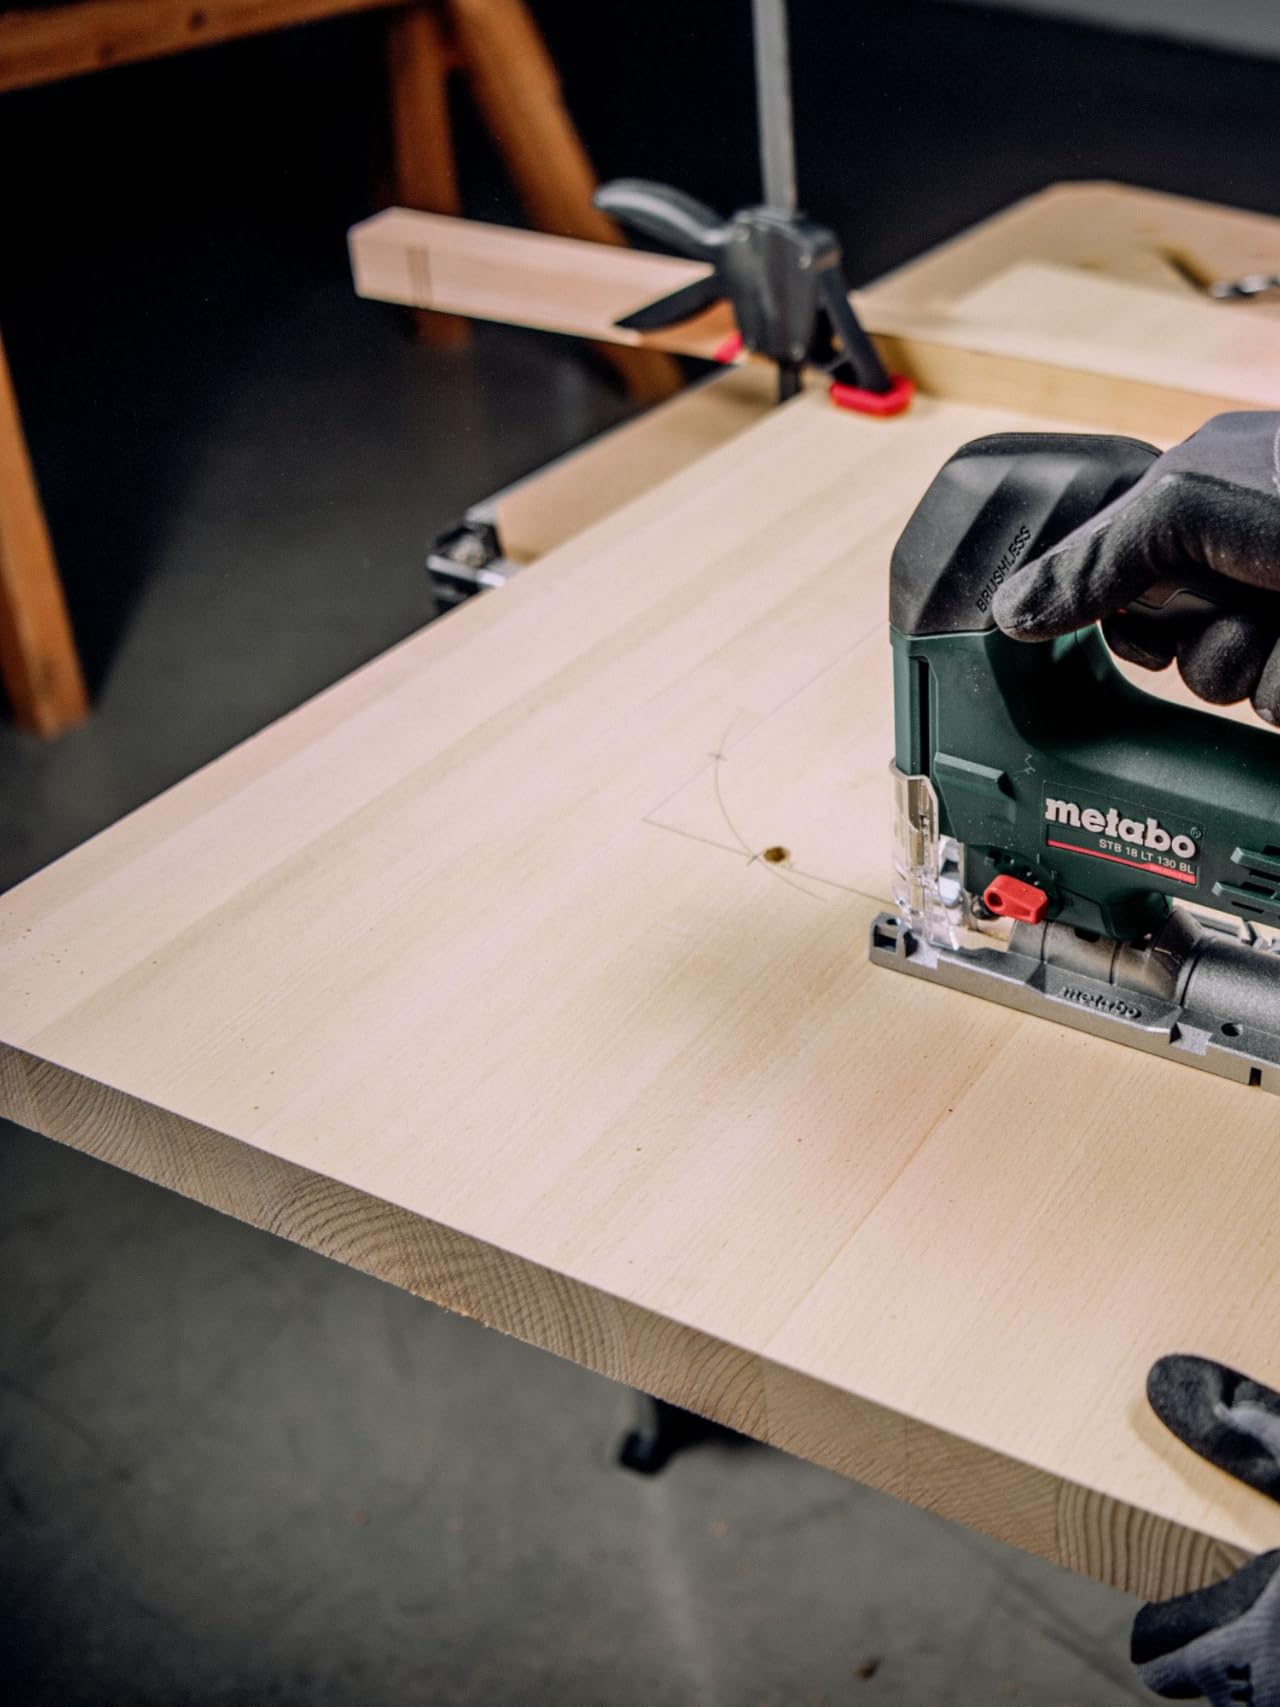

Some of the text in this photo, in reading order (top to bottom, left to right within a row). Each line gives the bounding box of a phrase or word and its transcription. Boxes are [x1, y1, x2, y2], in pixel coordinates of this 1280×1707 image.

[976, 526, 1031, 613] BRUSHLESS
[1045, 797, 1196, 859] metabo
[1099, 838, 1122, 854] STB
[1125, 846, 1139, 858] 18
[1141, 849, 1154, 862] LT
[1157, 855, 1177, 869] 130
[1179, 862, 1195, 875] BL
[1062, 985, 1142, 1019] metabo
